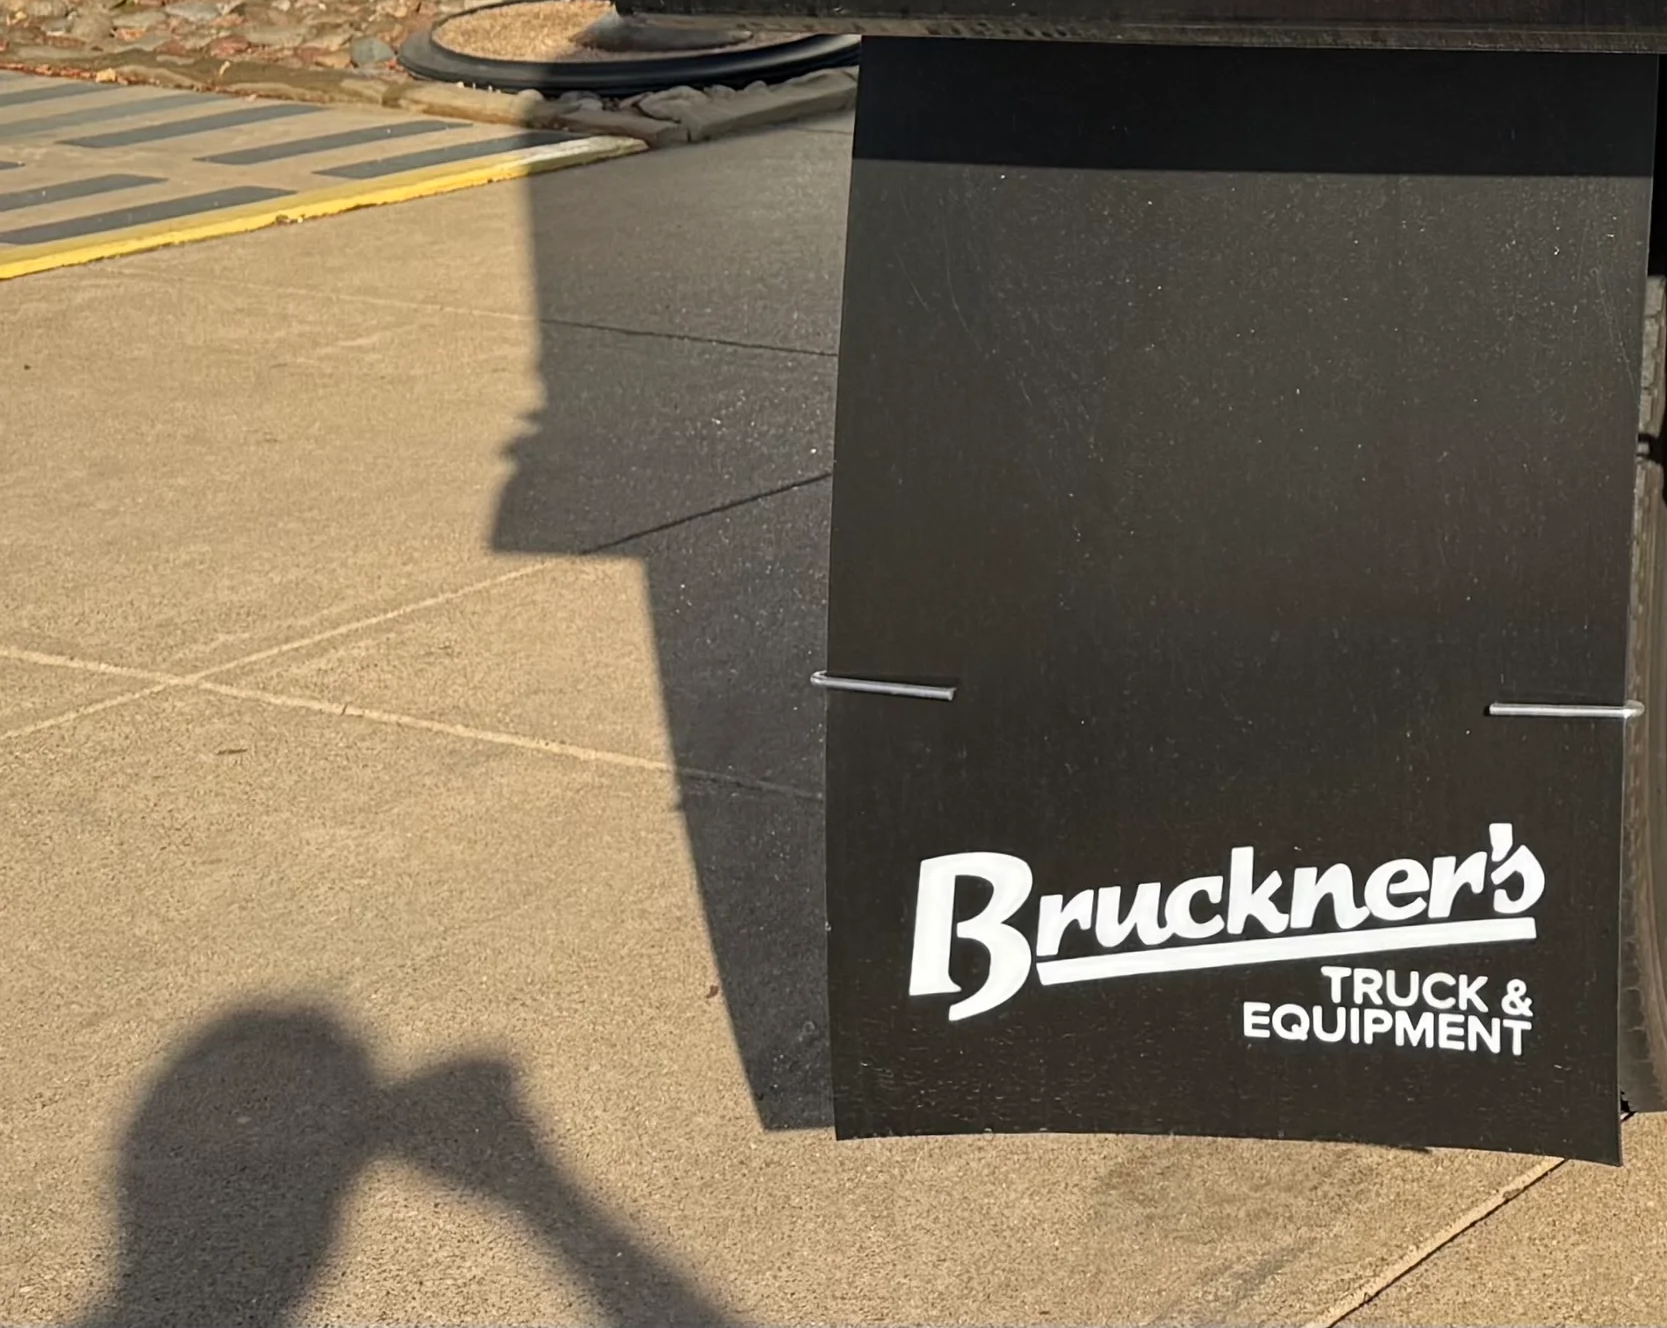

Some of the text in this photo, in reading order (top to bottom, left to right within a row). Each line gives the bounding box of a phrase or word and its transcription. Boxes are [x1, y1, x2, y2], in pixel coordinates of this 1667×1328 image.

[909, 822, 1545, 1022] Bruckner's
[1320, 966, 1533, 1018] TRUCK &
[1243, 1001, 1533, 1057] EQUIPMENT
